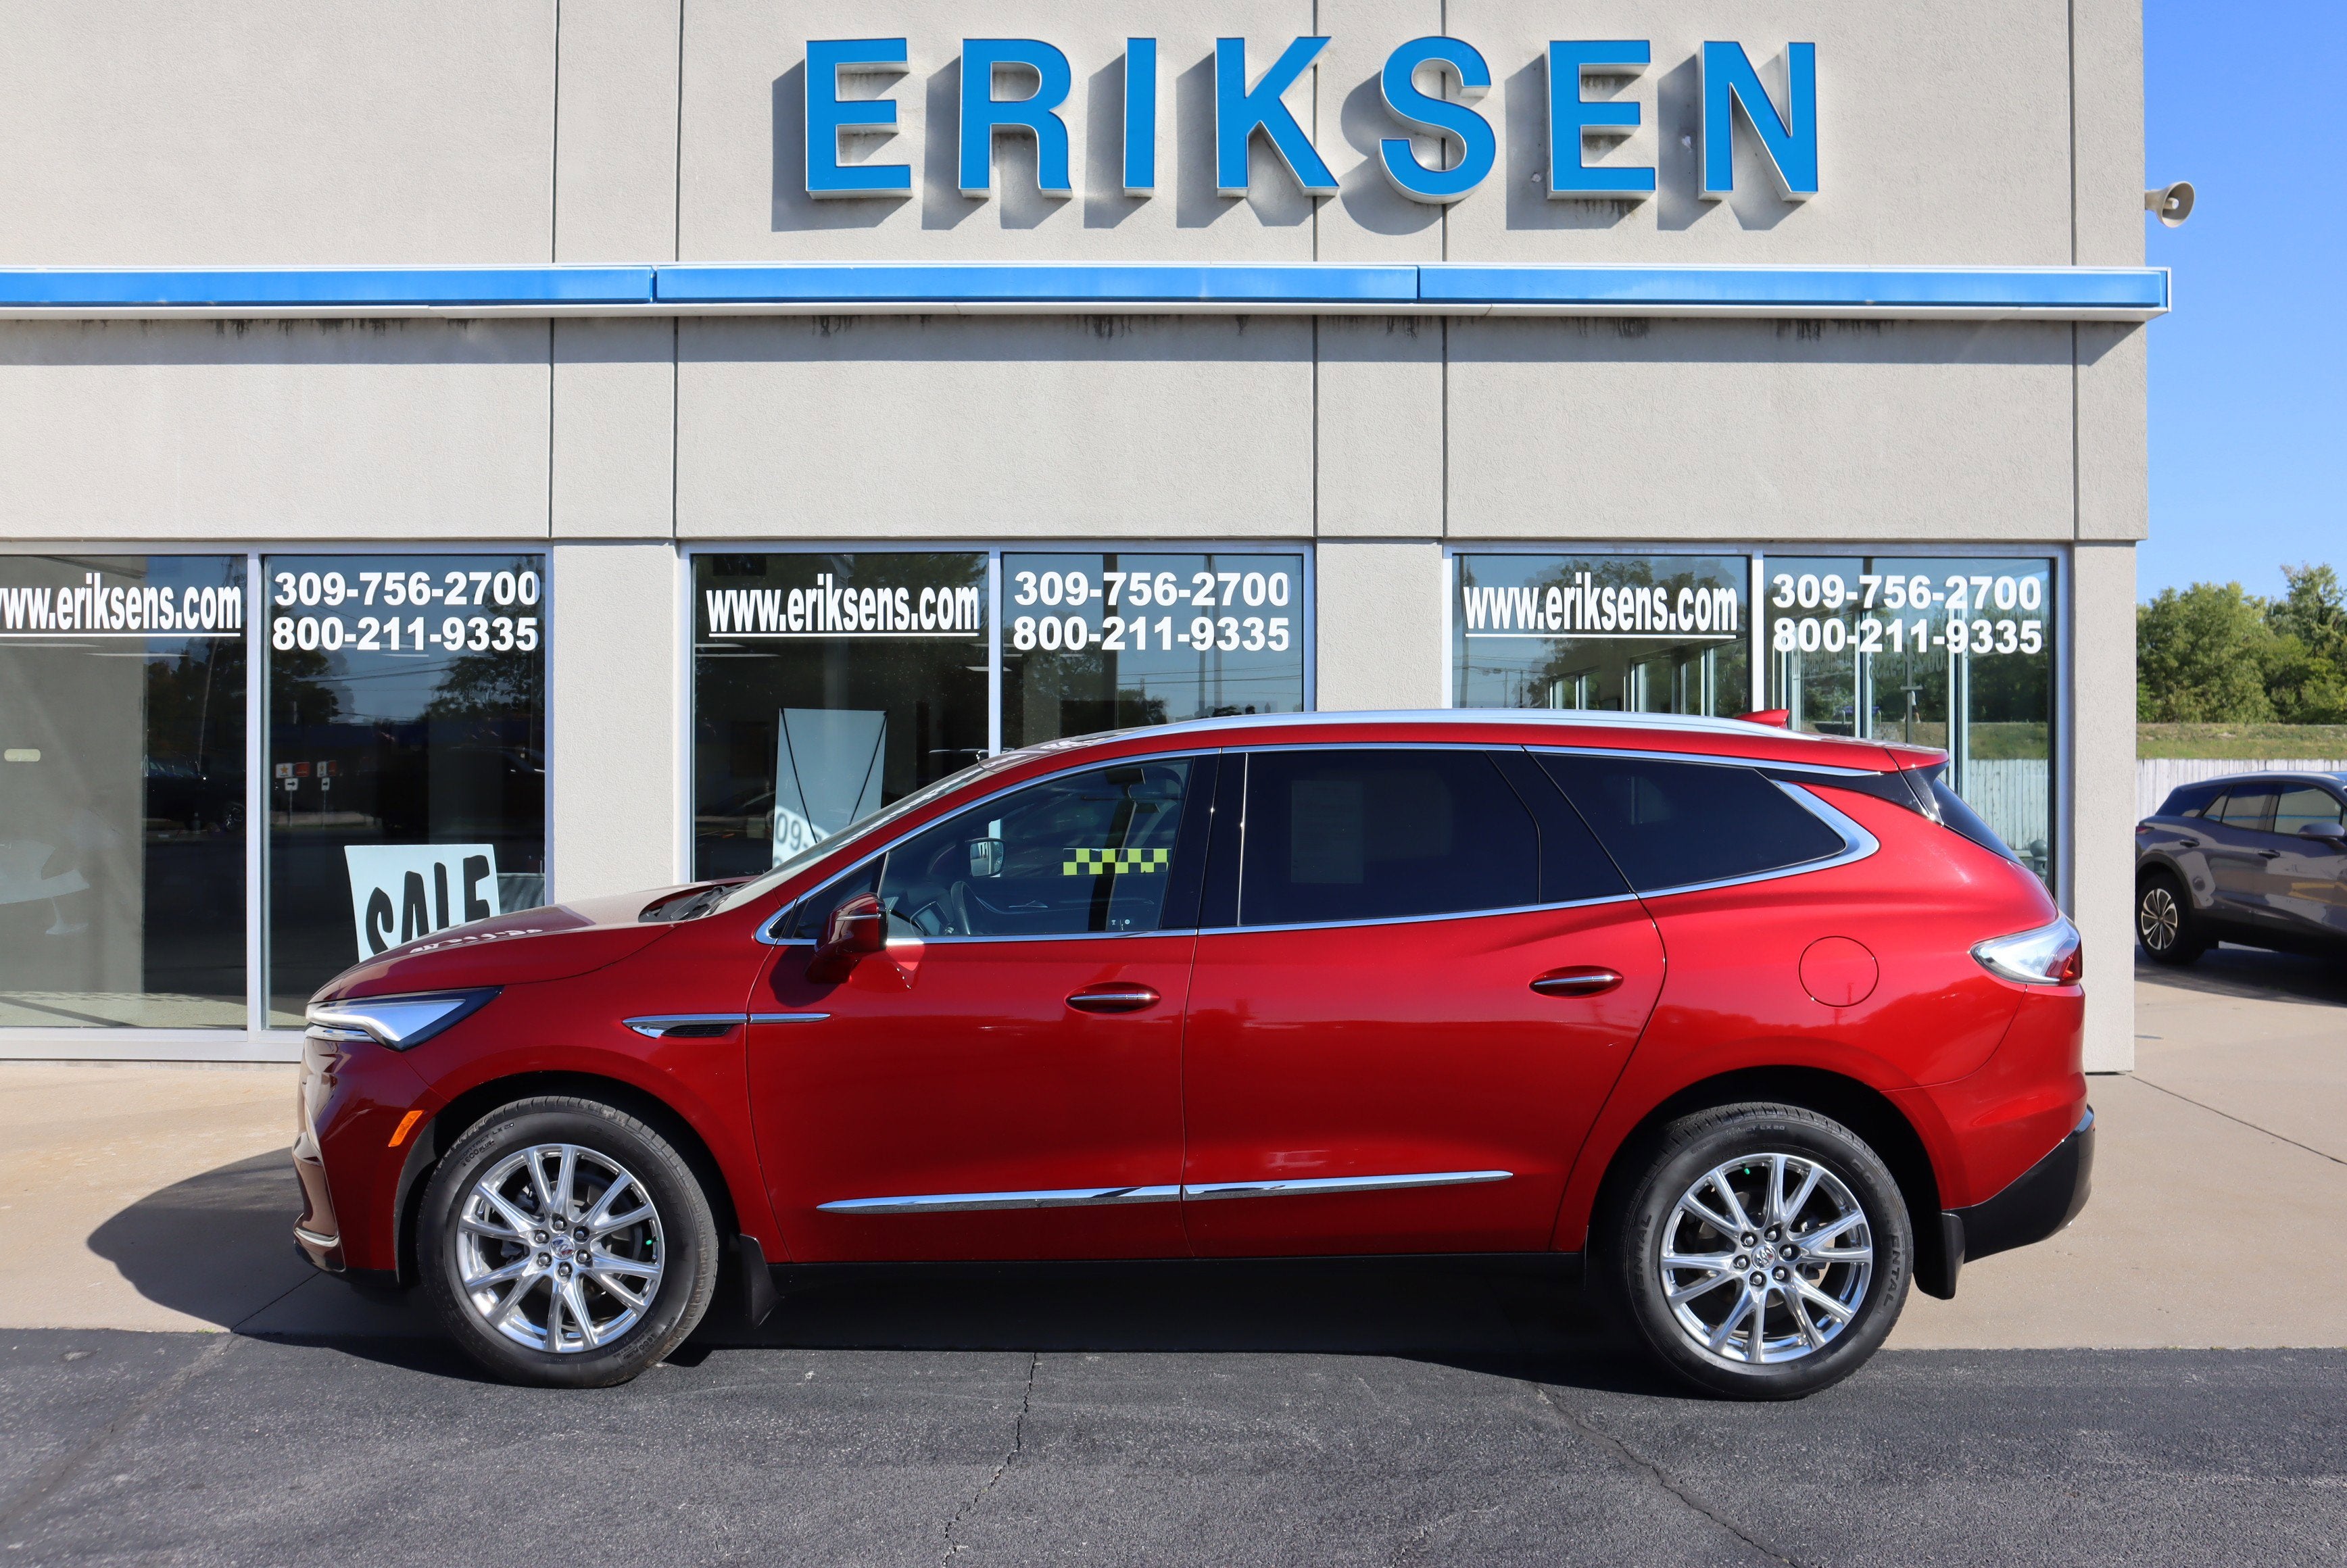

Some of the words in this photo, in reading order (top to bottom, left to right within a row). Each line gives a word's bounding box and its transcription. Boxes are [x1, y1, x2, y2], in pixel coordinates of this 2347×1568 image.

[804, 35, 1818, 203] ERIKSEN
[0, 572, 241, 630] ww.eriksens.com
[274, 571, 539, 606] 309-756-2700
[706, 573, 979, 632] www.eriksens.com
[1014, 571, 1290, 606] 309-756-2700
[1463, 572, 1737, 631] www.eriksens.com
[1772, 574, 2041, 610] 309-756-2700
[272, 616, 538, 651] 800-211-9335
[1013, 616, 1290, 651] 800-211-9335
[1773, 618, 2041, 654] 800-211-9335
